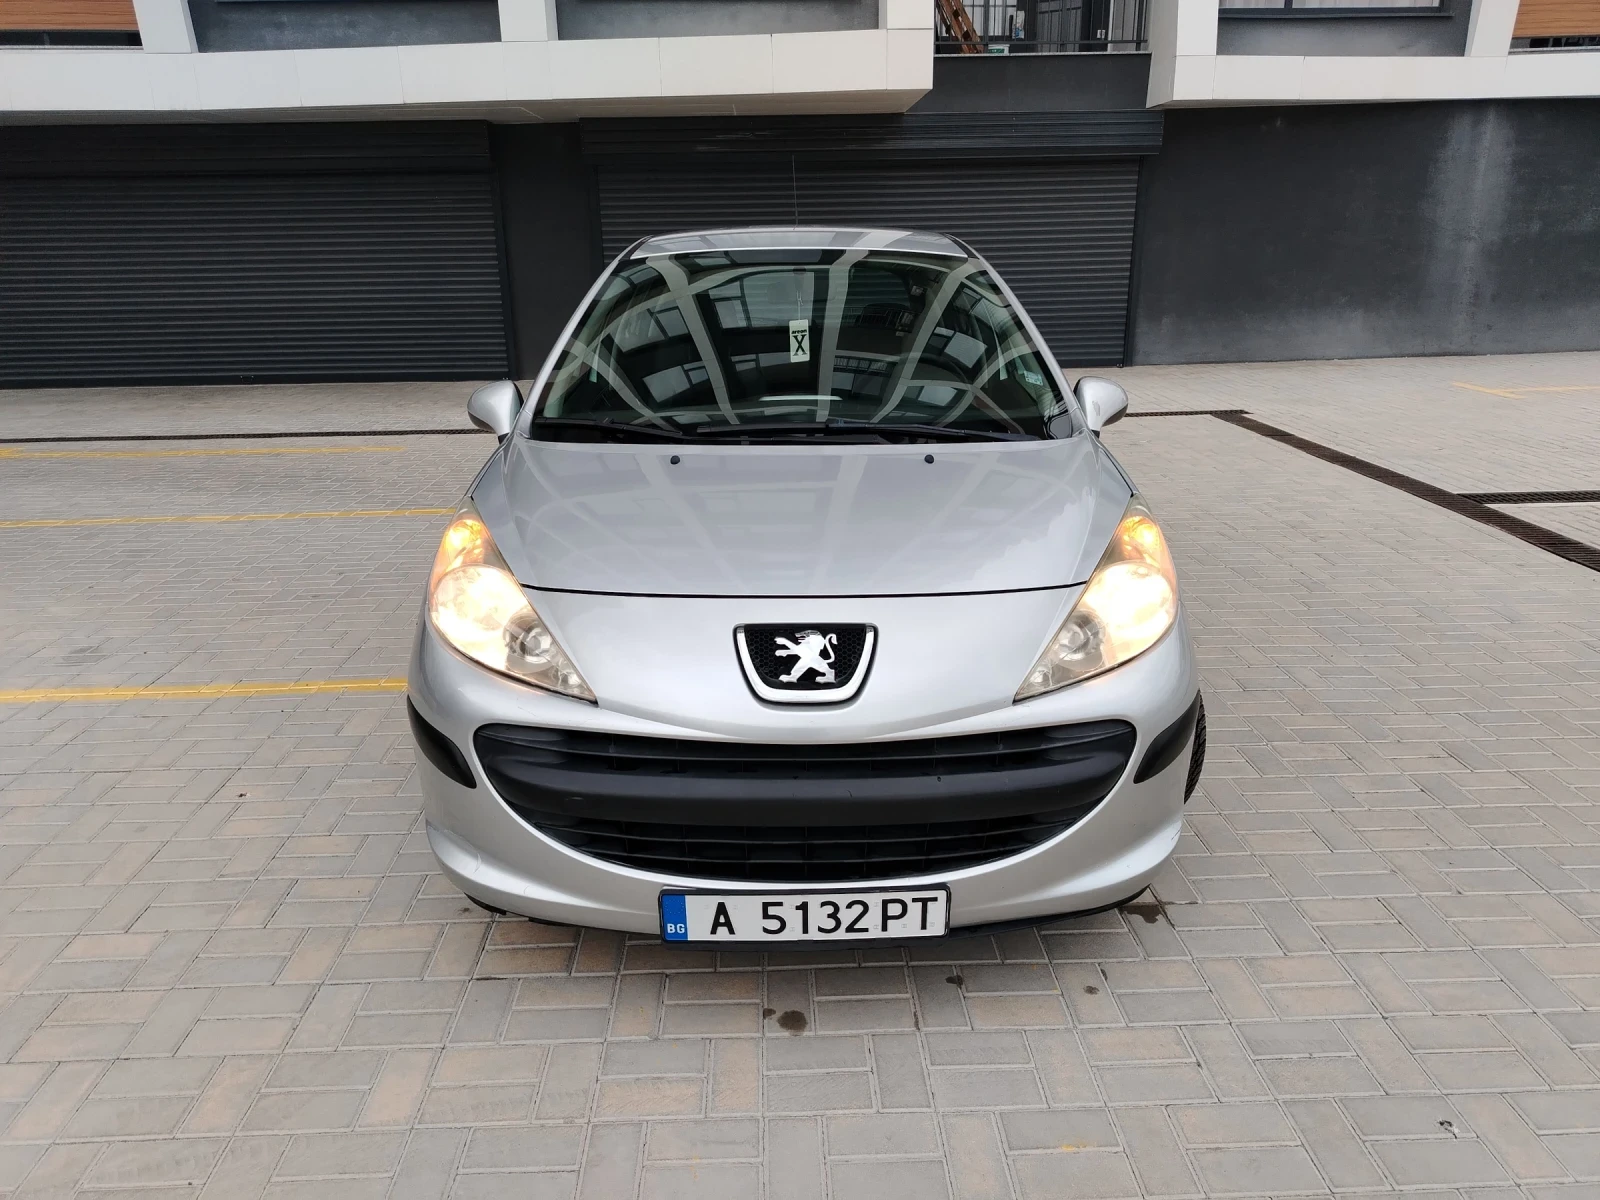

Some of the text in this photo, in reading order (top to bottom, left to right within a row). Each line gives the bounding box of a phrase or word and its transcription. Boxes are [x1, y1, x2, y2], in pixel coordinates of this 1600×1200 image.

[793, 334, 807, 356] X
[666, 923, 686, 934] BG
[709, 901, 736, 935] A
